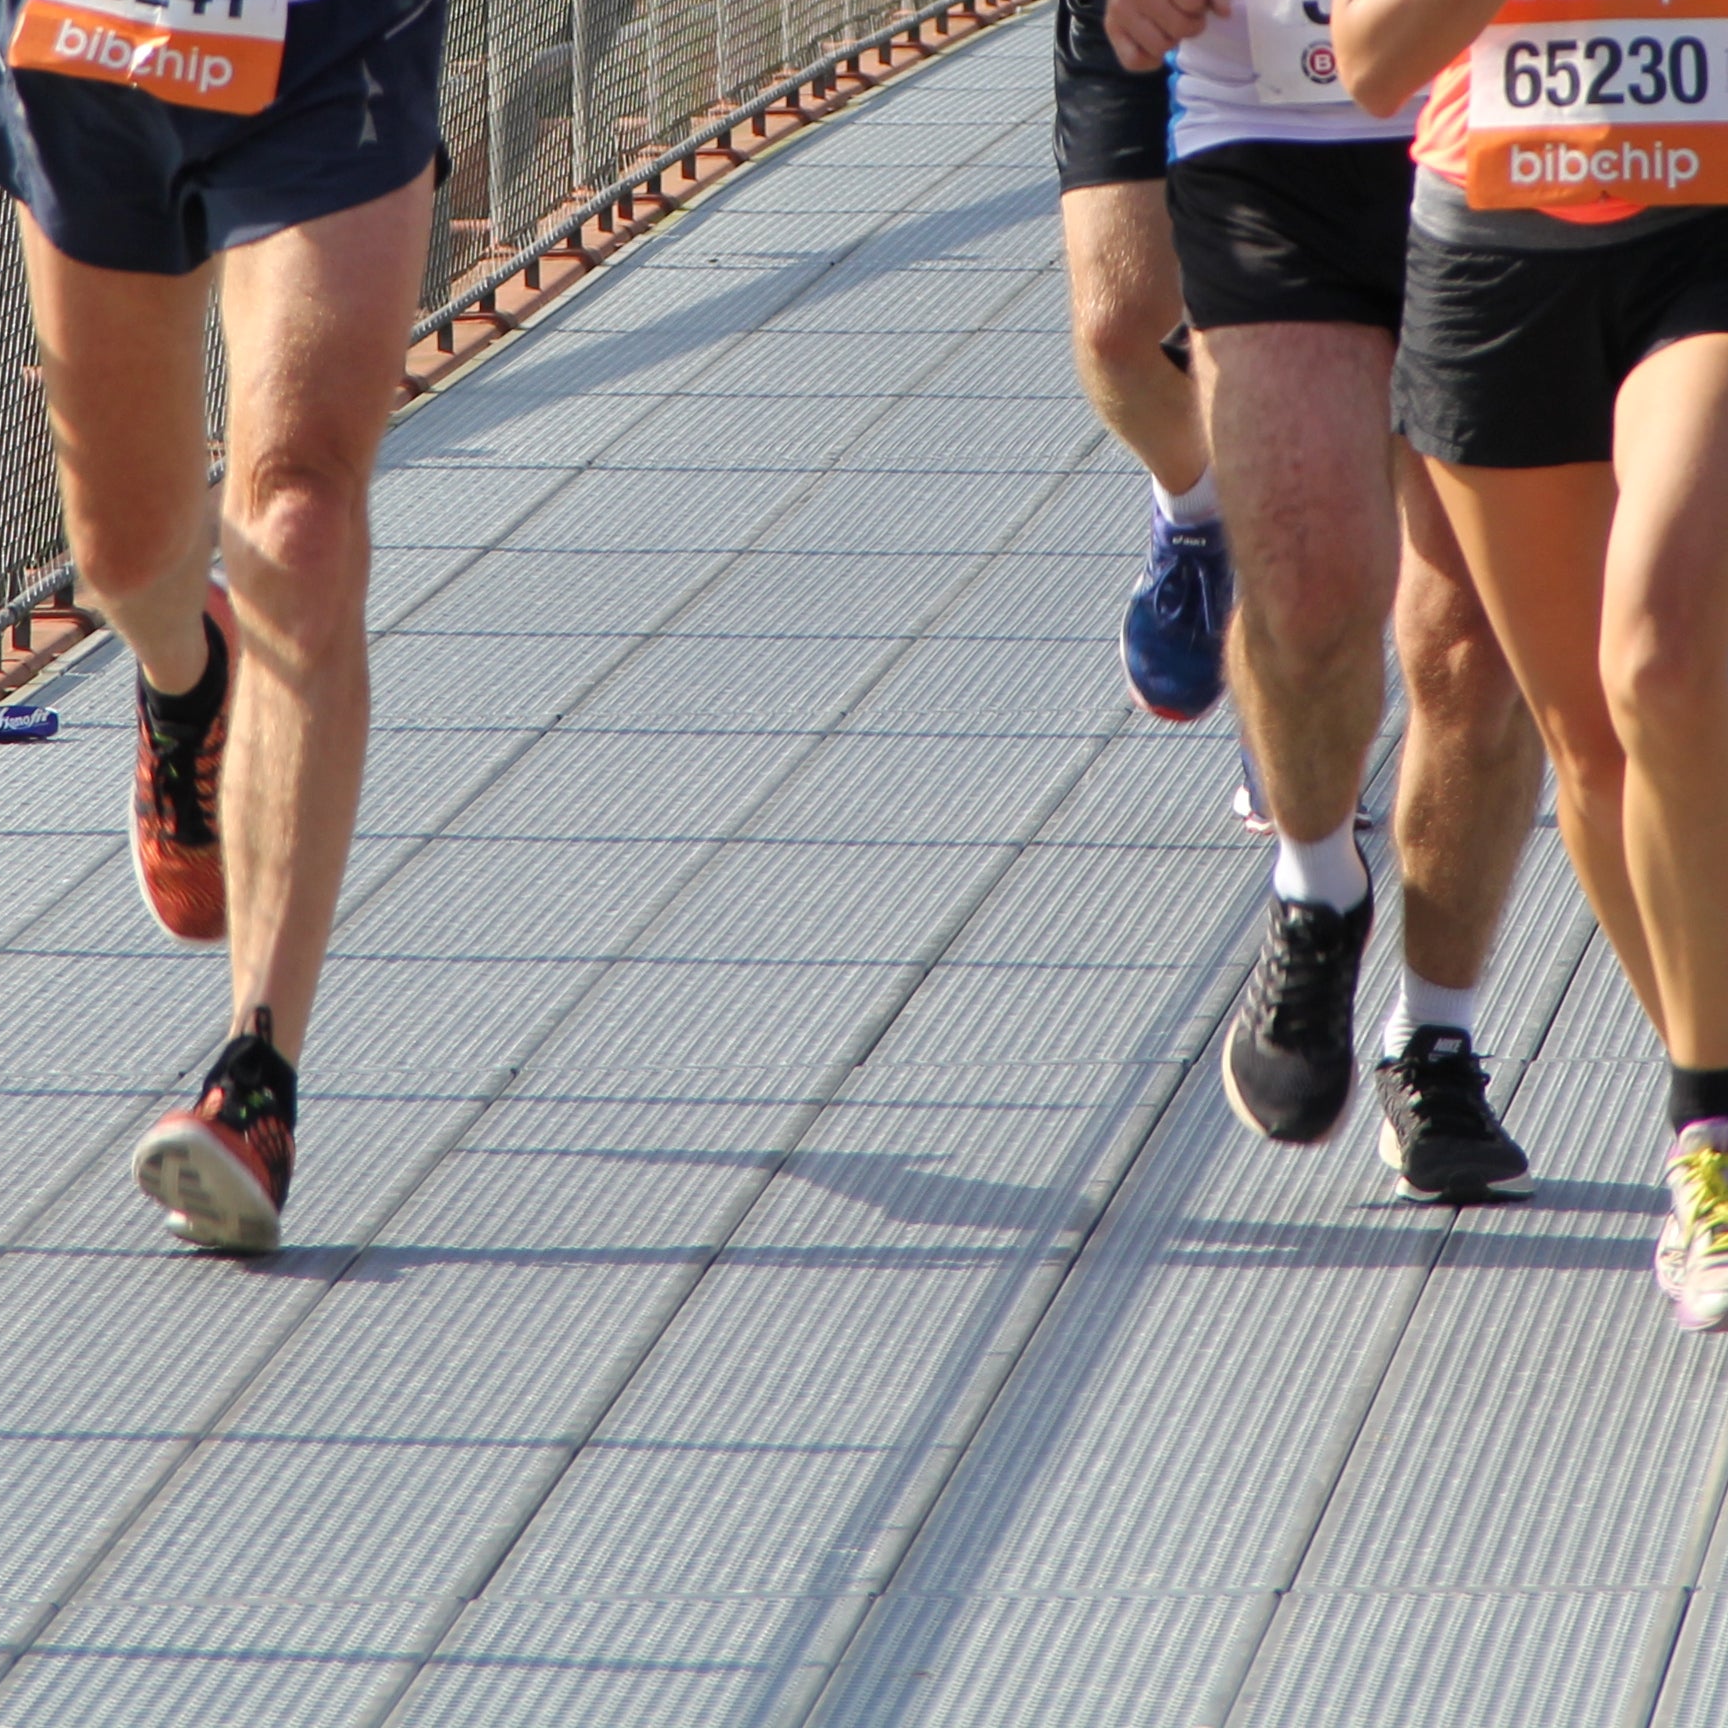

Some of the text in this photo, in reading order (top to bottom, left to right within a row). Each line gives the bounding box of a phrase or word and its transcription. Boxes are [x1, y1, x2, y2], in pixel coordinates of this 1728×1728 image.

[55, 19, 234, 93] bibchip
[1503, 35, 1709, 108] 65230
[1510, 141, 1700, 190] bibchip
